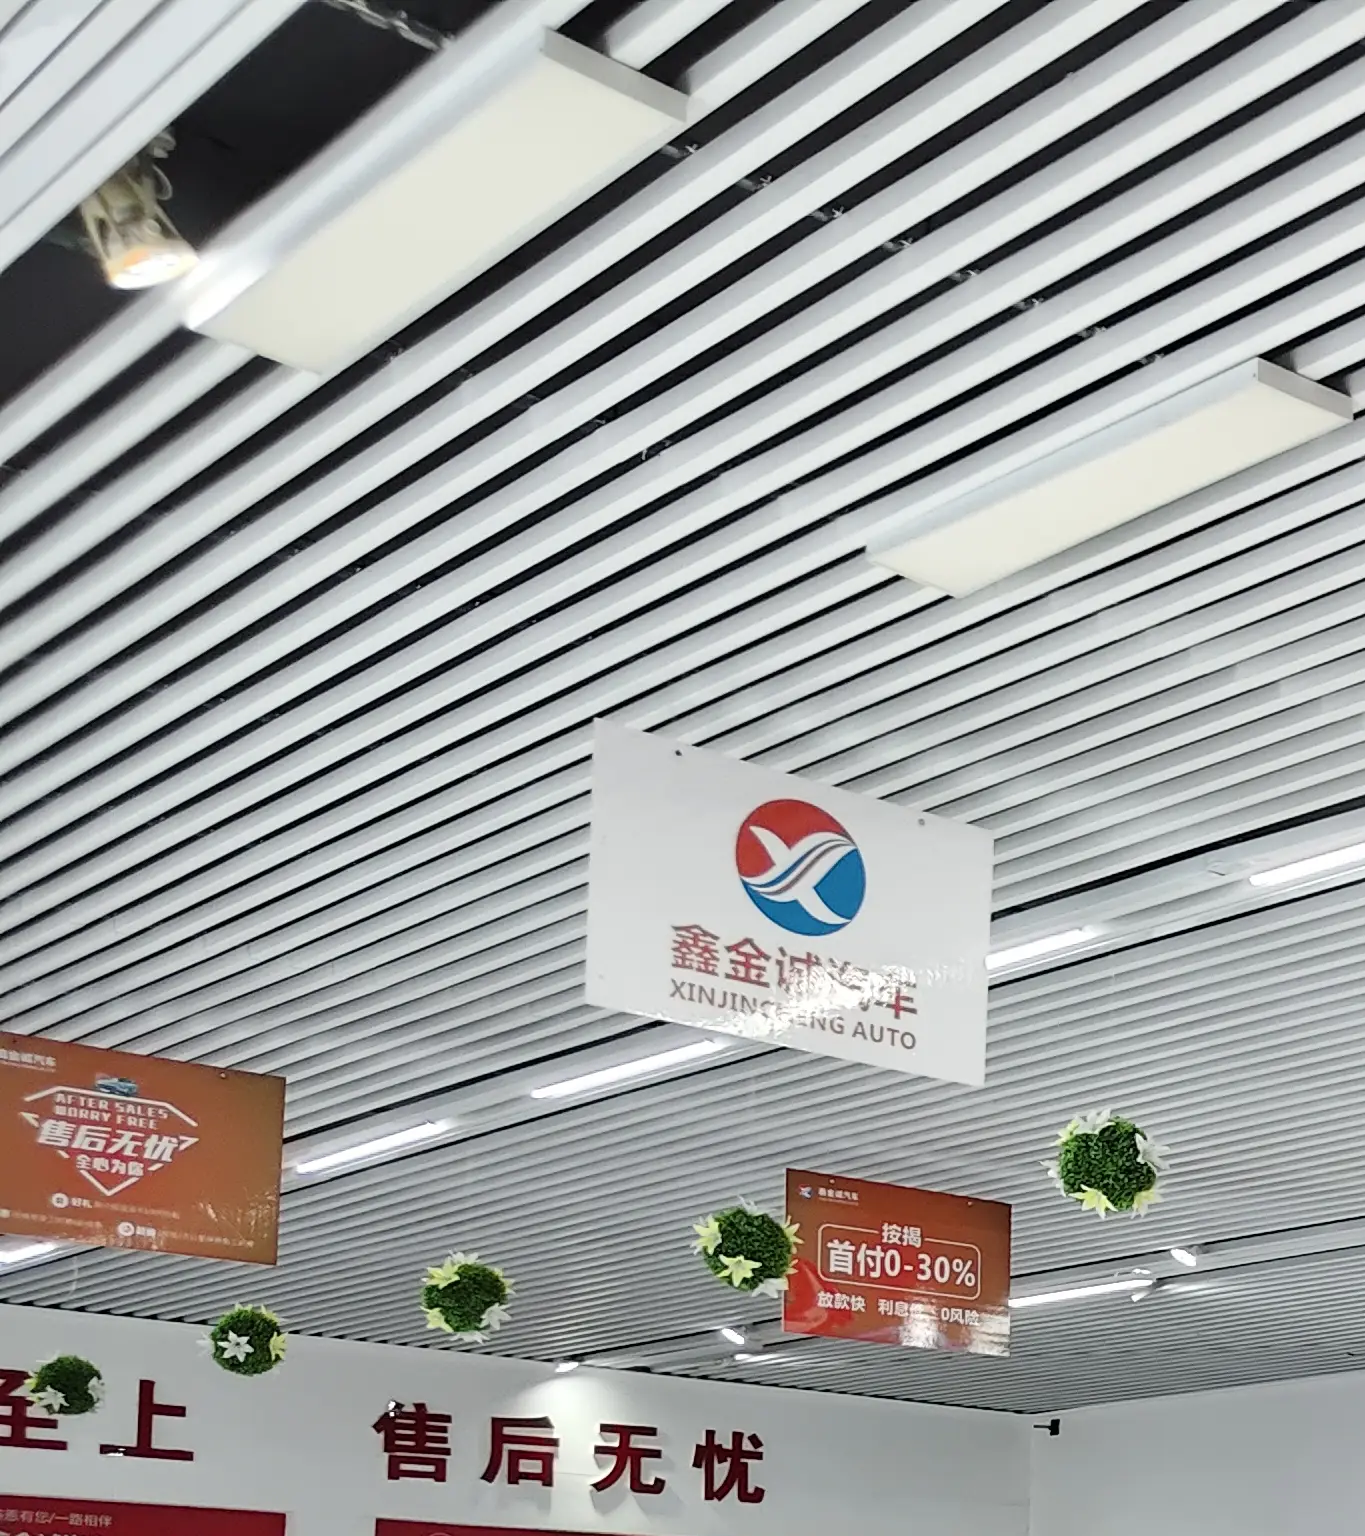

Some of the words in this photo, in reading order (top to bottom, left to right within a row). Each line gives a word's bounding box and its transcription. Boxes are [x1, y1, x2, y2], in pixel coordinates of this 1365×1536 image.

[852, 1021, 917, 1050] AUTO
[53, 1092, 110, 1111] AFTER
[115, 1101, 170, 1119] SALES
[54, 1105, 111, 1122] WORRY
[116, 1114, 158, 1130] FREE
[36, 1118, 181, 1162] 售后无忧
[76, 1154, 144, 1177] 全心为你
[881, 1222, 923, 1249] 按揭
[826, 1238, 977, 1287] 首付0-30%
[817, 1290, 867, 1313] 放款快
[940, 1307, 980, 1327] 0风险
[373, 1400, 766, 1504] 售后无忧
